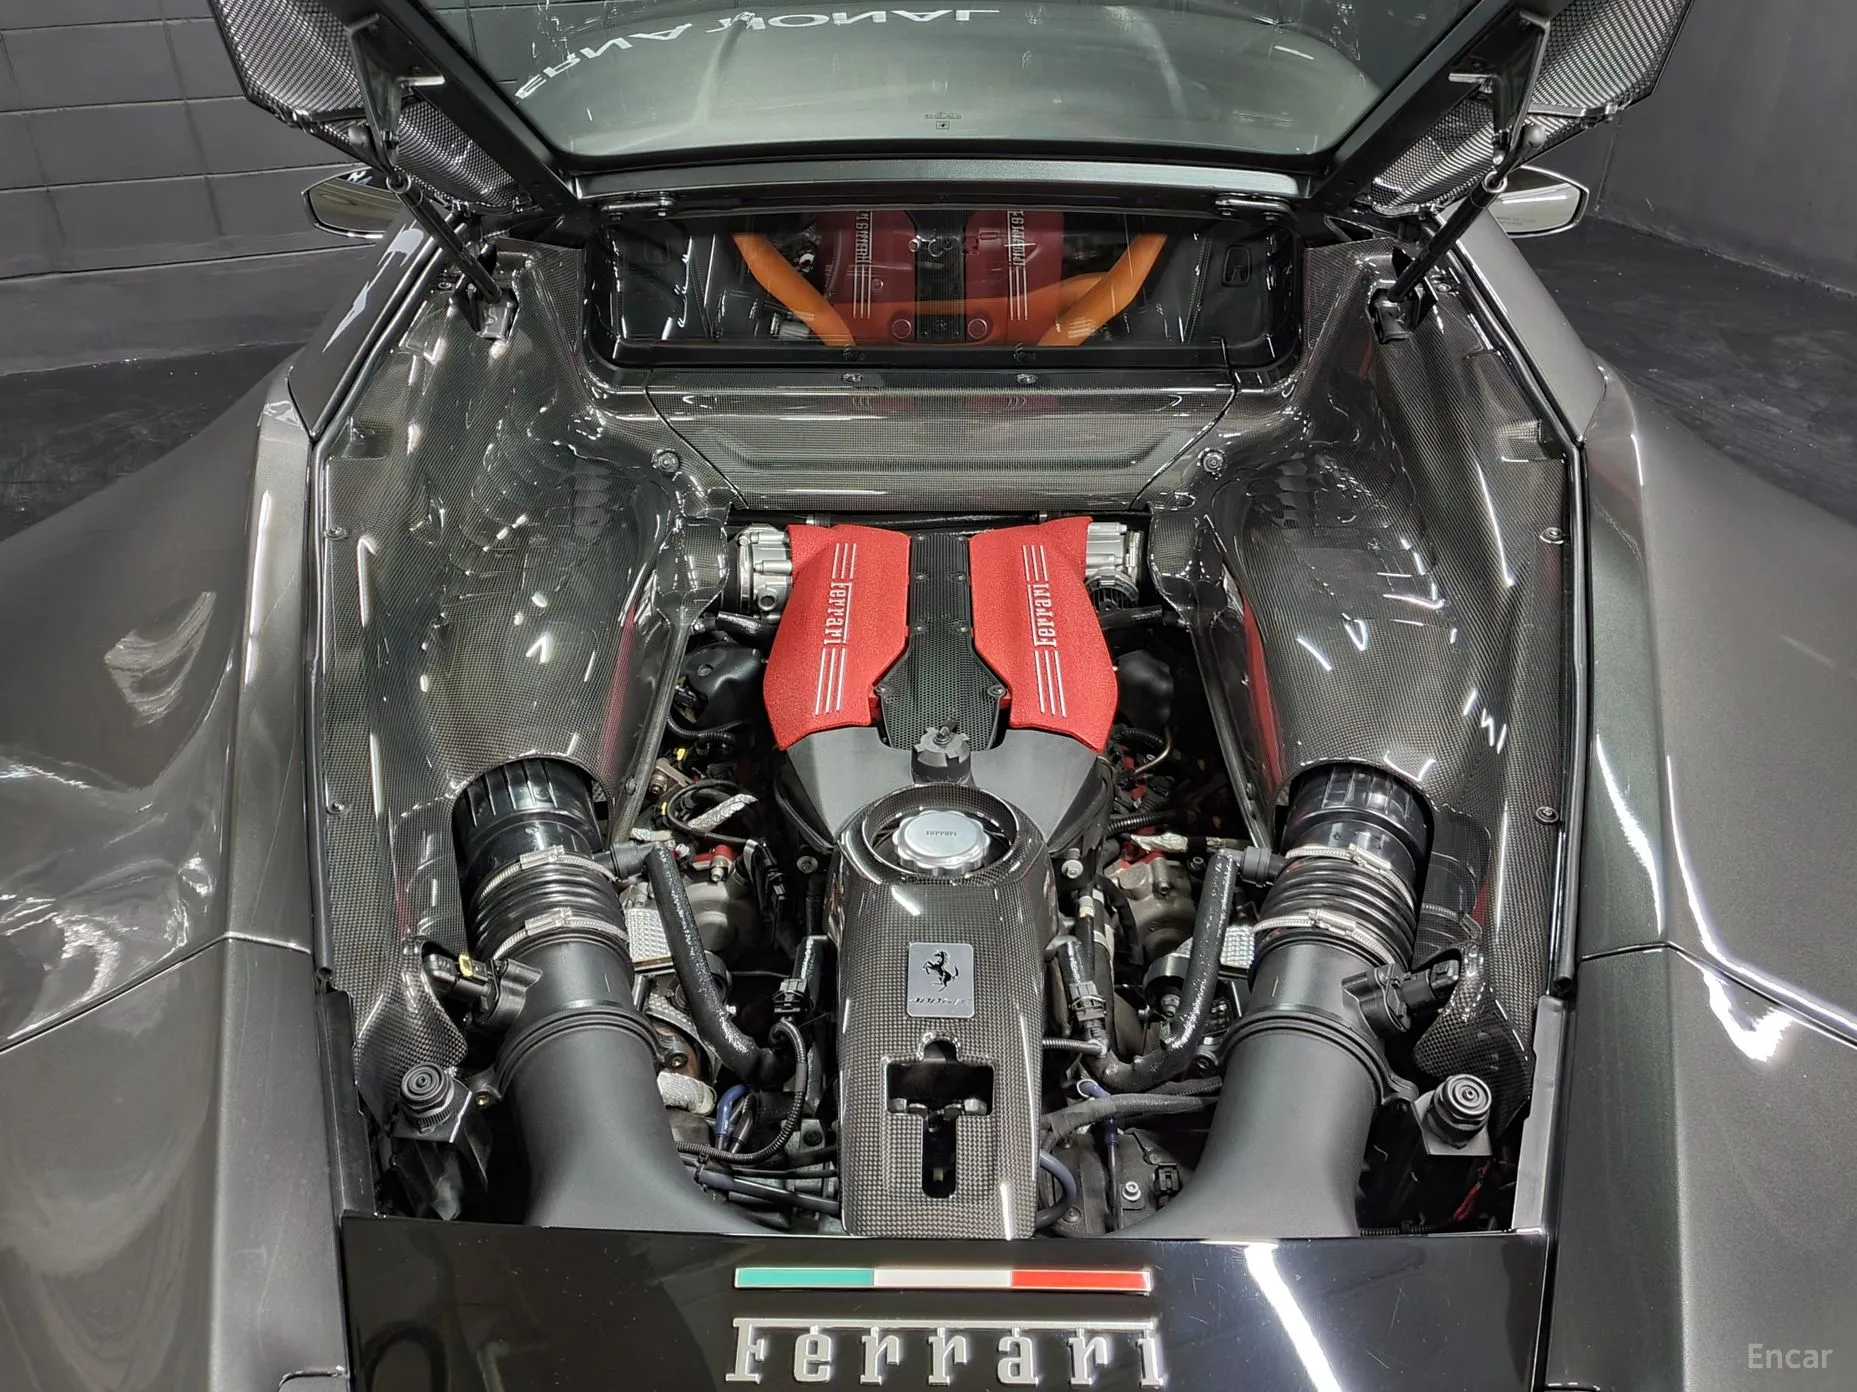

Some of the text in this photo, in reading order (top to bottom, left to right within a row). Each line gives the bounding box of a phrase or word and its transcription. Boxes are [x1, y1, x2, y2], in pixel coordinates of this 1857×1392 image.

[822, 582, 853, 645] Ferrari
[1027, 583, 1058, 647] Ferrari
[725, 1317, 1165, 1388] Ferrari
